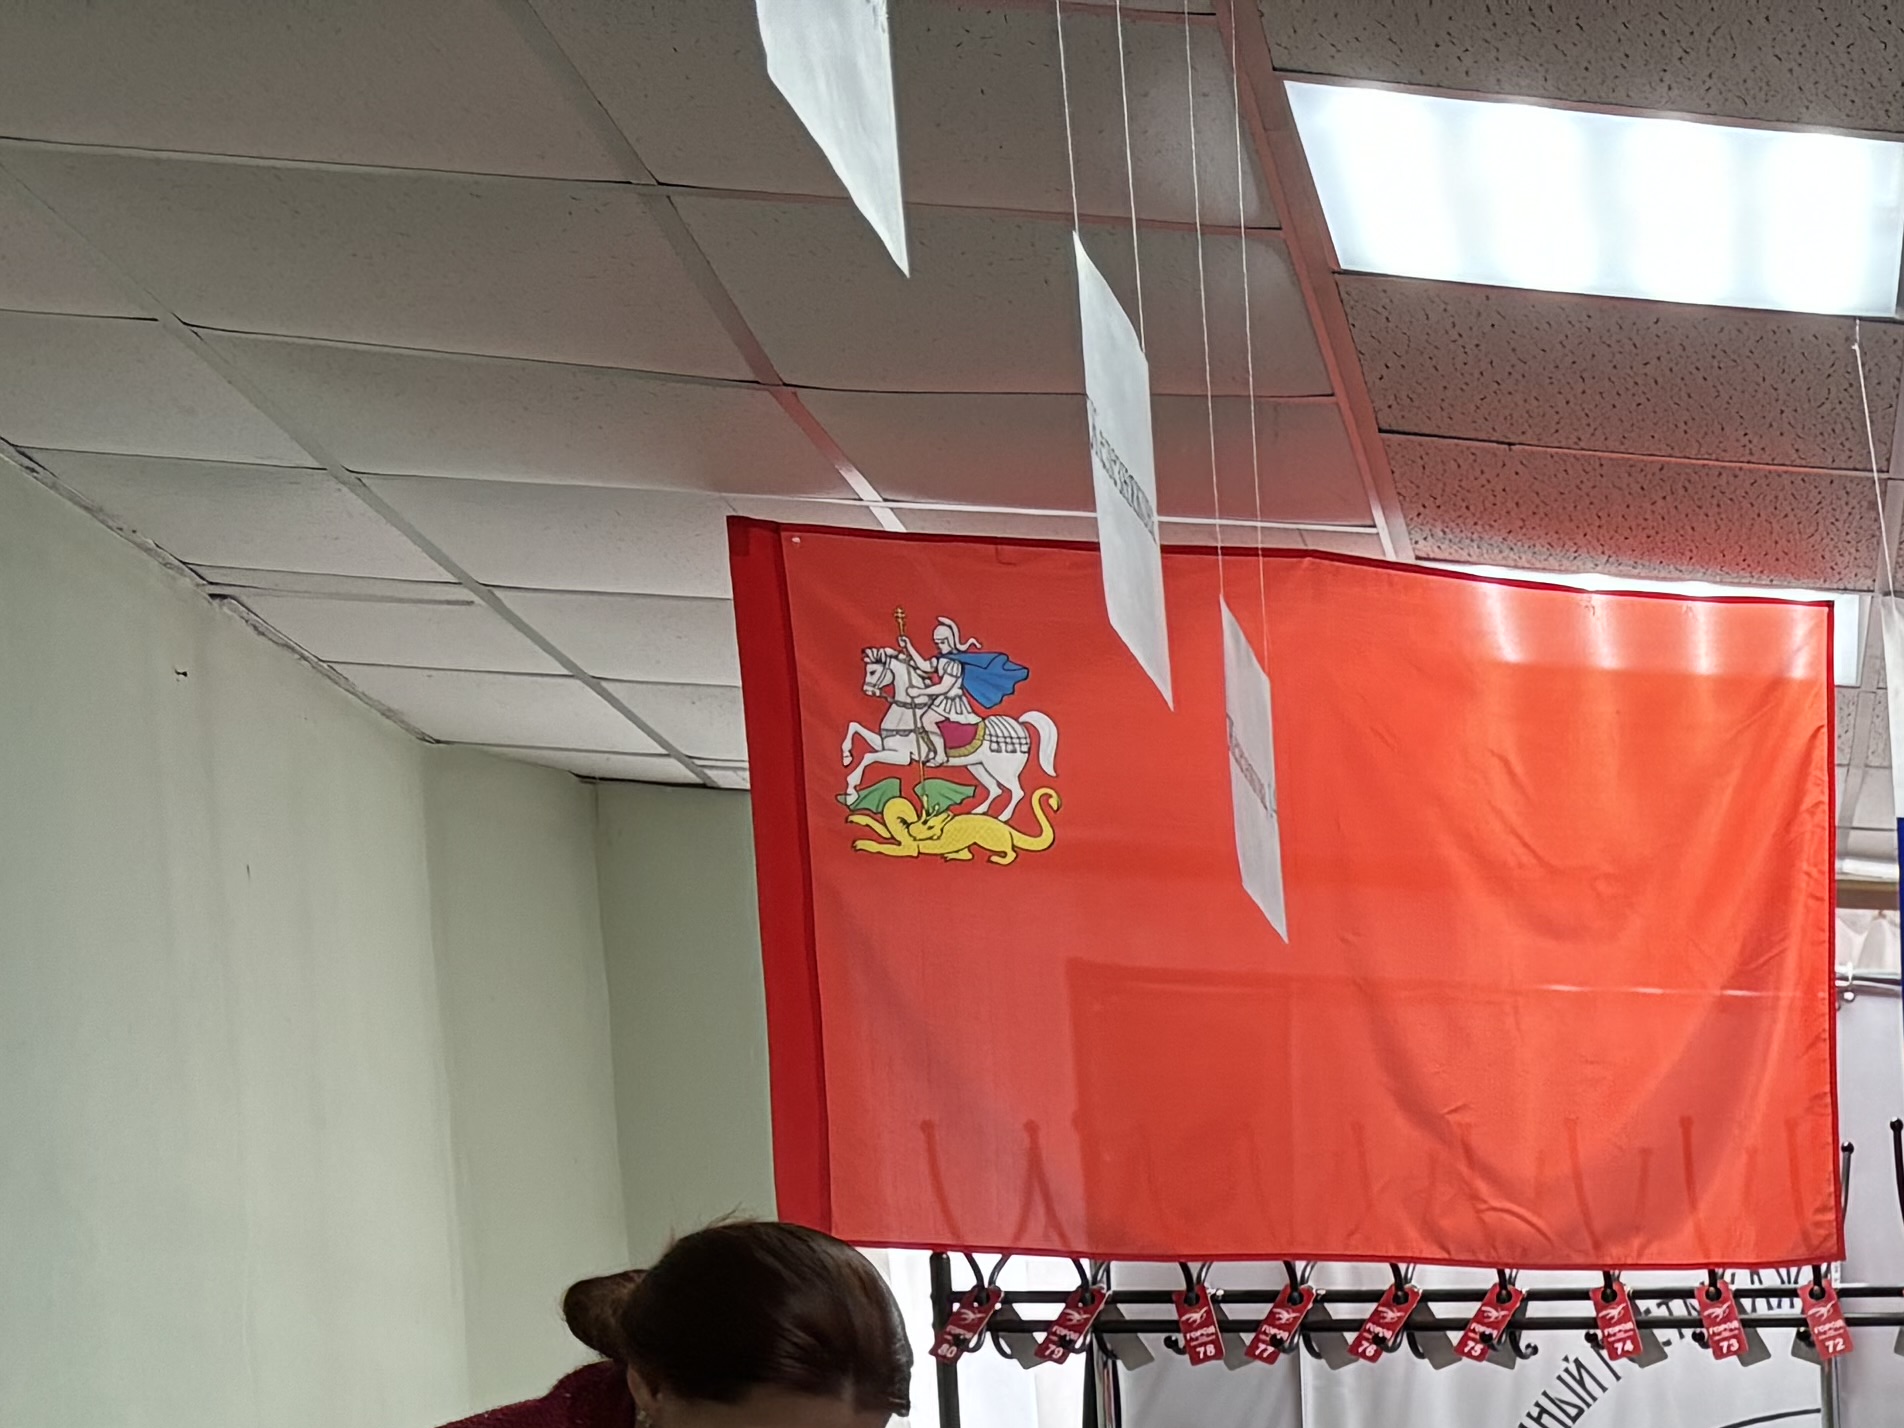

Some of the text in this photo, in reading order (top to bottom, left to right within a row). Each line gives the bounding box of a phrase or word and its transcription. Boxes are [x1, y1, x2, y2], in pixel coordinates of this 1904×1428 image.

[1254, 1344, 1275, 1358] 77
[1357, 1341, 1375, 1356] 76
[1463, 1341, 1481, 1355] 75
[1613, 1341, 1633, 1354] 74
[1719, 1341, 1740, 1353] 73
[1825, 1339, 1845, 1352] 72
[1043, 1345, 1064, 1360] 79
[1197, 1346, 1216, 1359] 78
